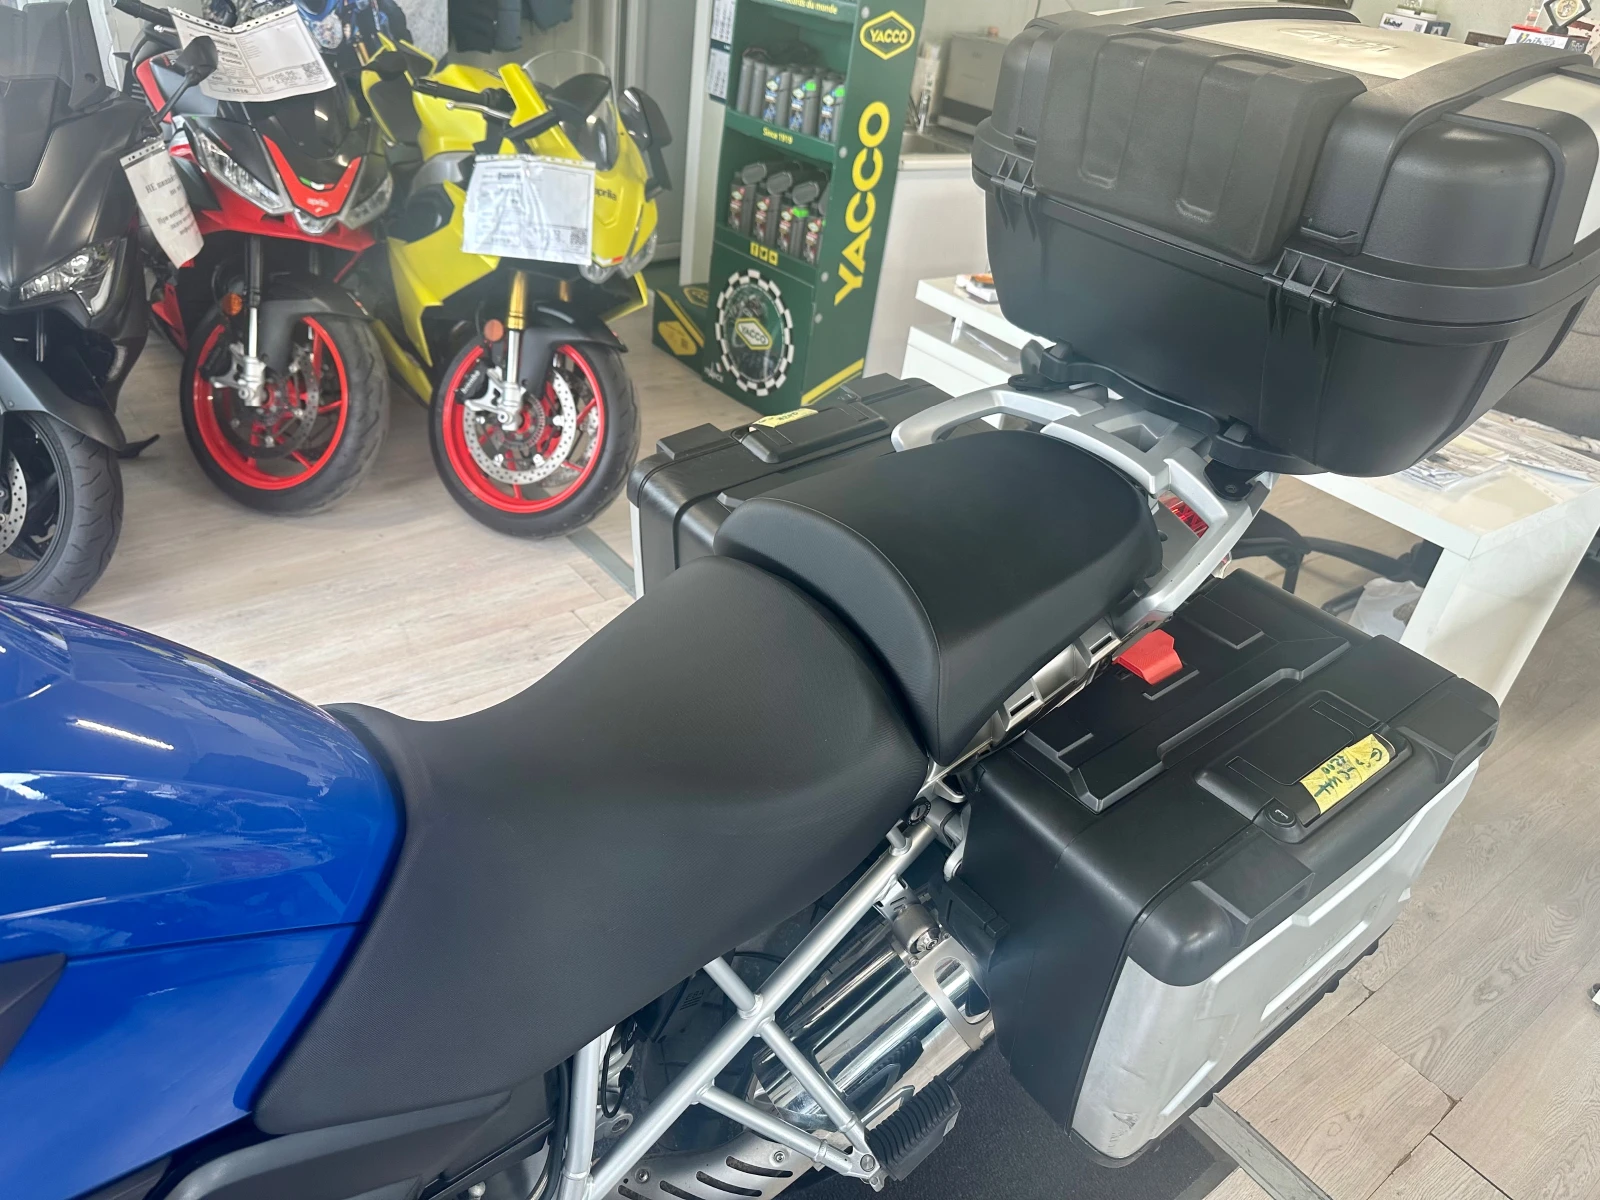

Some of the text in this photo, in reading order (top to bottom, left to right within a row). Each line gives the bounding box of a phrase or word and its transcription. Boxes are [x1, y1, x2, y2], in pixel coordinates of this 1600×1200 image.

[869, 29, 909, 44] YACCO
[778, 130, 794, 145] 1919
[834, 101, 890, 306] YACCO
[740, 323, 767, 344] YACCO
